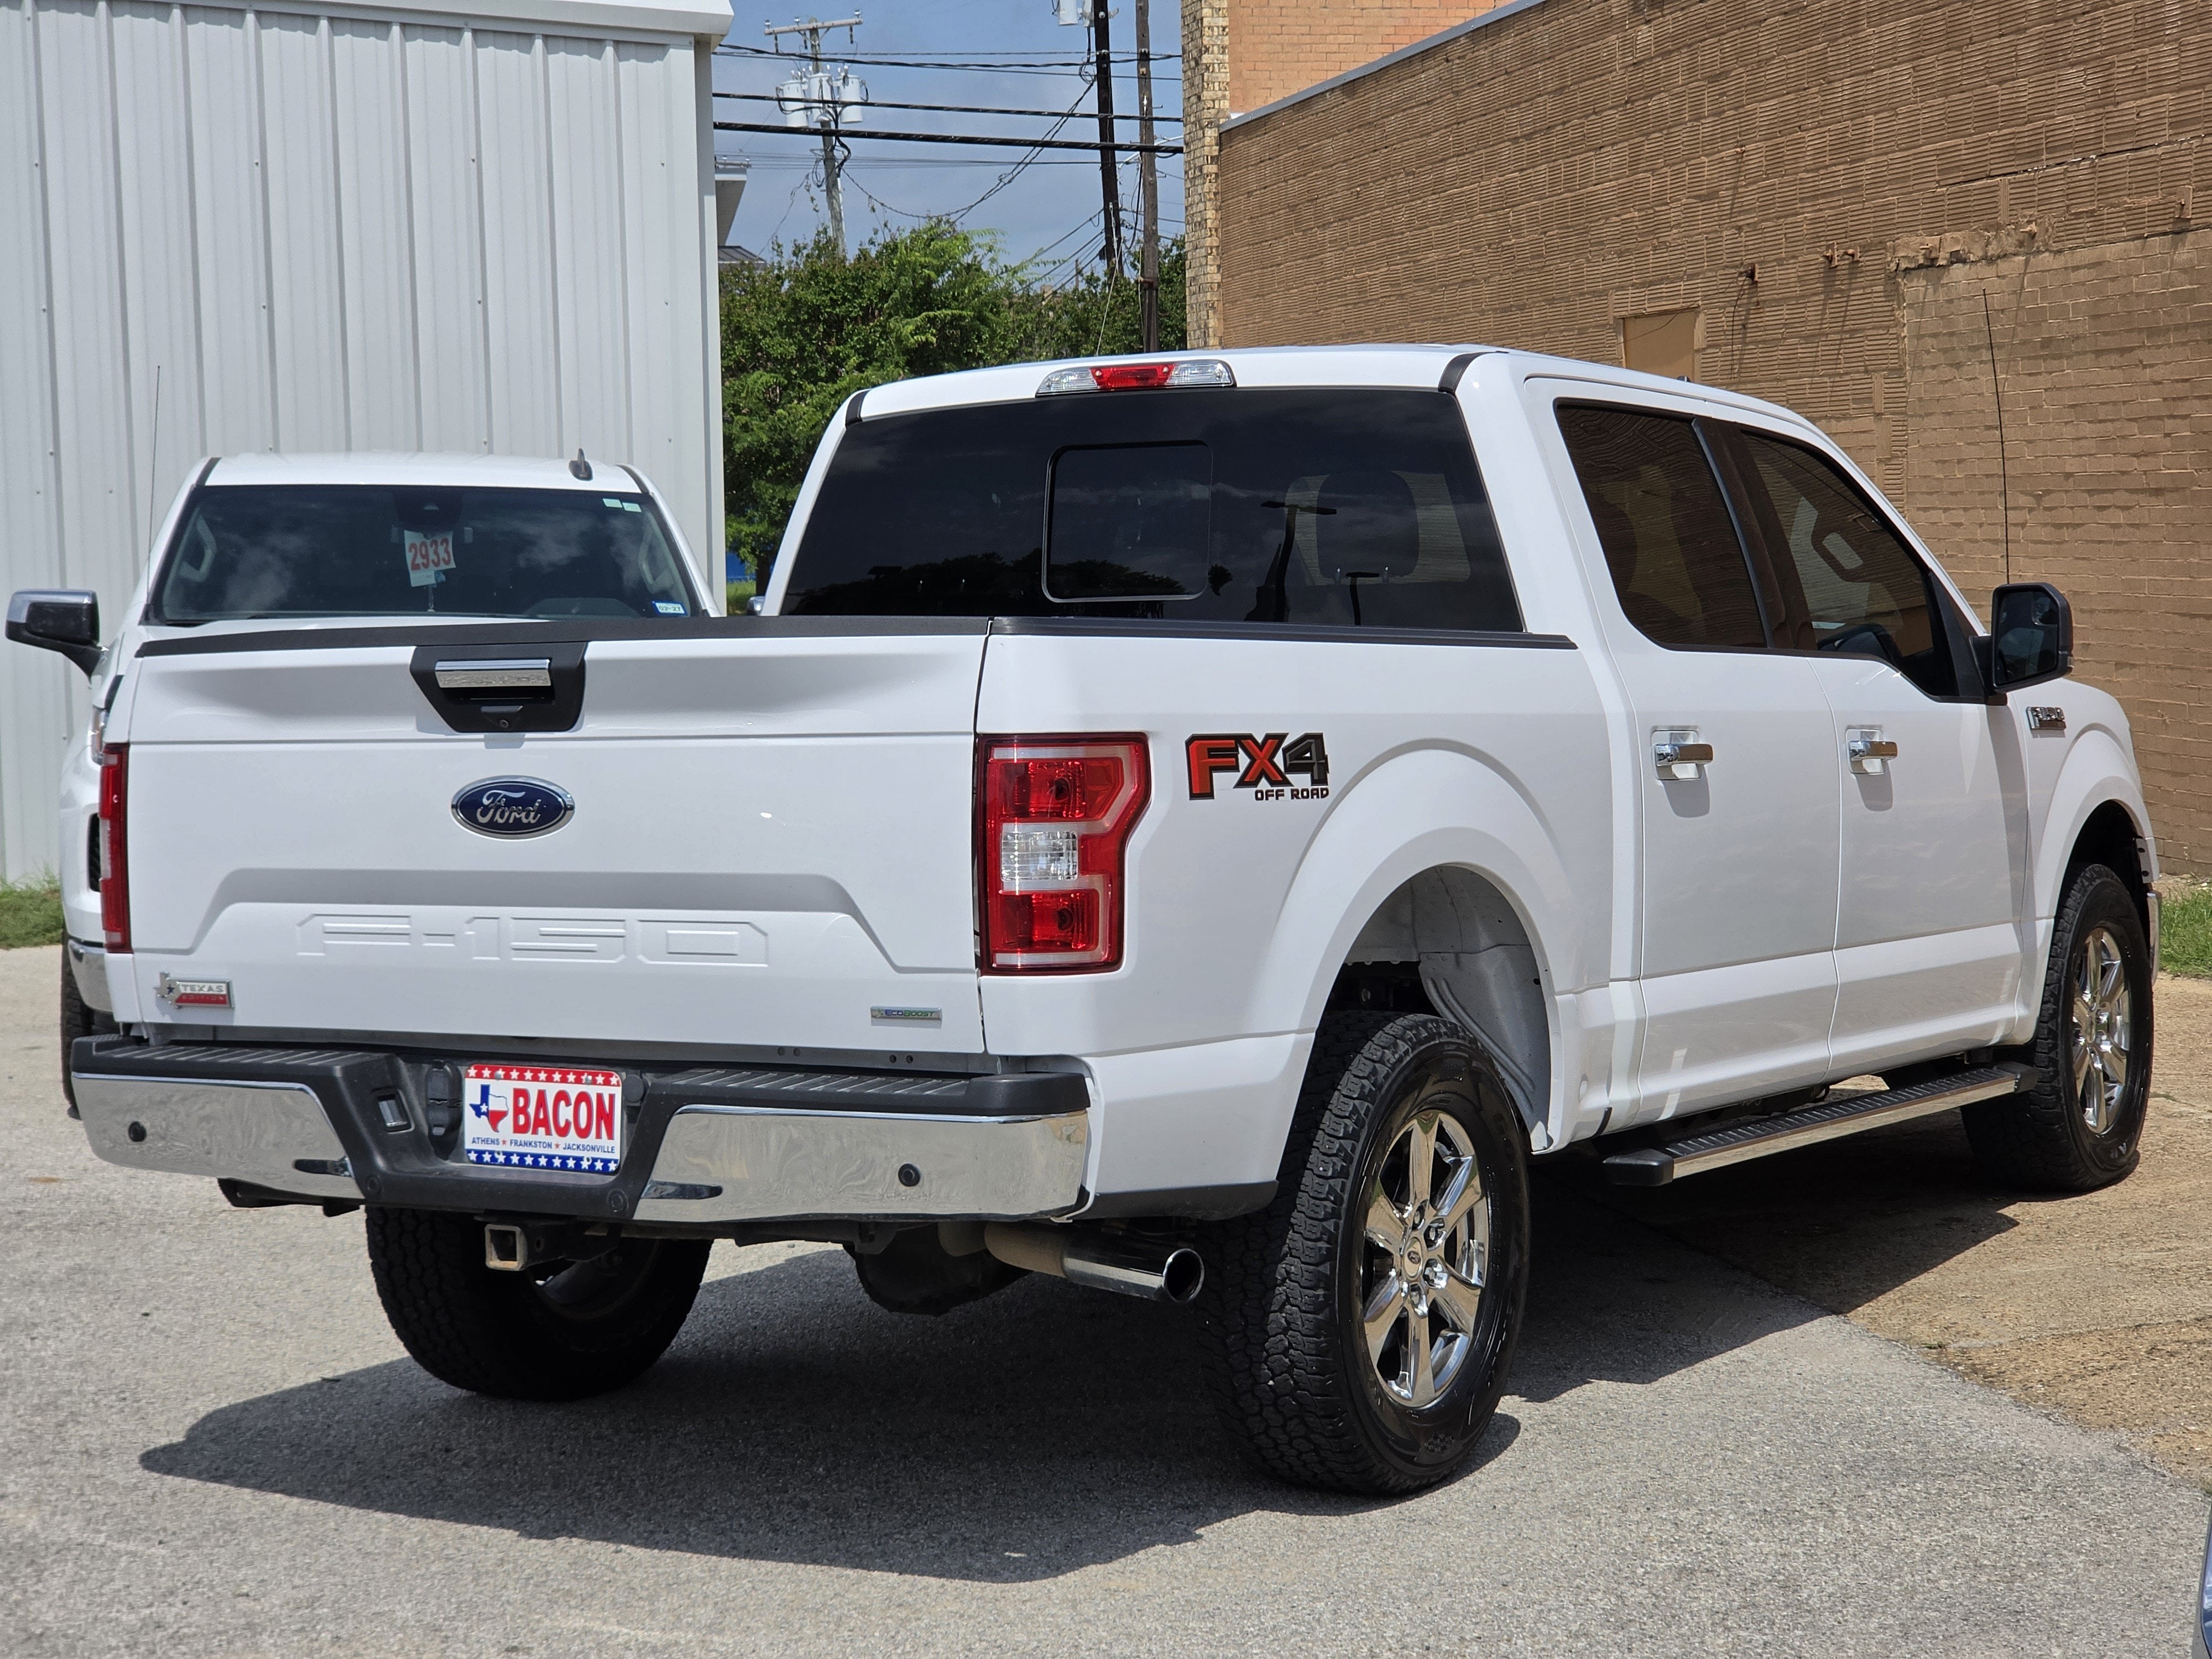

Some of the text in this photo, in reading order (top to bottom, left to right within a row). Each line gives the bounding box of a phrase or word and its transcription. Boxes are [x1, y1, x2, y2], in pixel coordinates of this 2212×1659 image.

[409, 538, 451, 570] 2933
[1185, 733, 1329, 800] FX4
[476, 790, 541, 824] Ford
[1255, 787, 1329, 801] OFF ROAD
[297, 913, 768, 967] F-150
[181, 984, 224, 993] TEXAS
[513, 1087, 615, 1141] BACON
[471, 1137, 615, 1154] ATHENS FRANKSTON JACKSONVILLE
